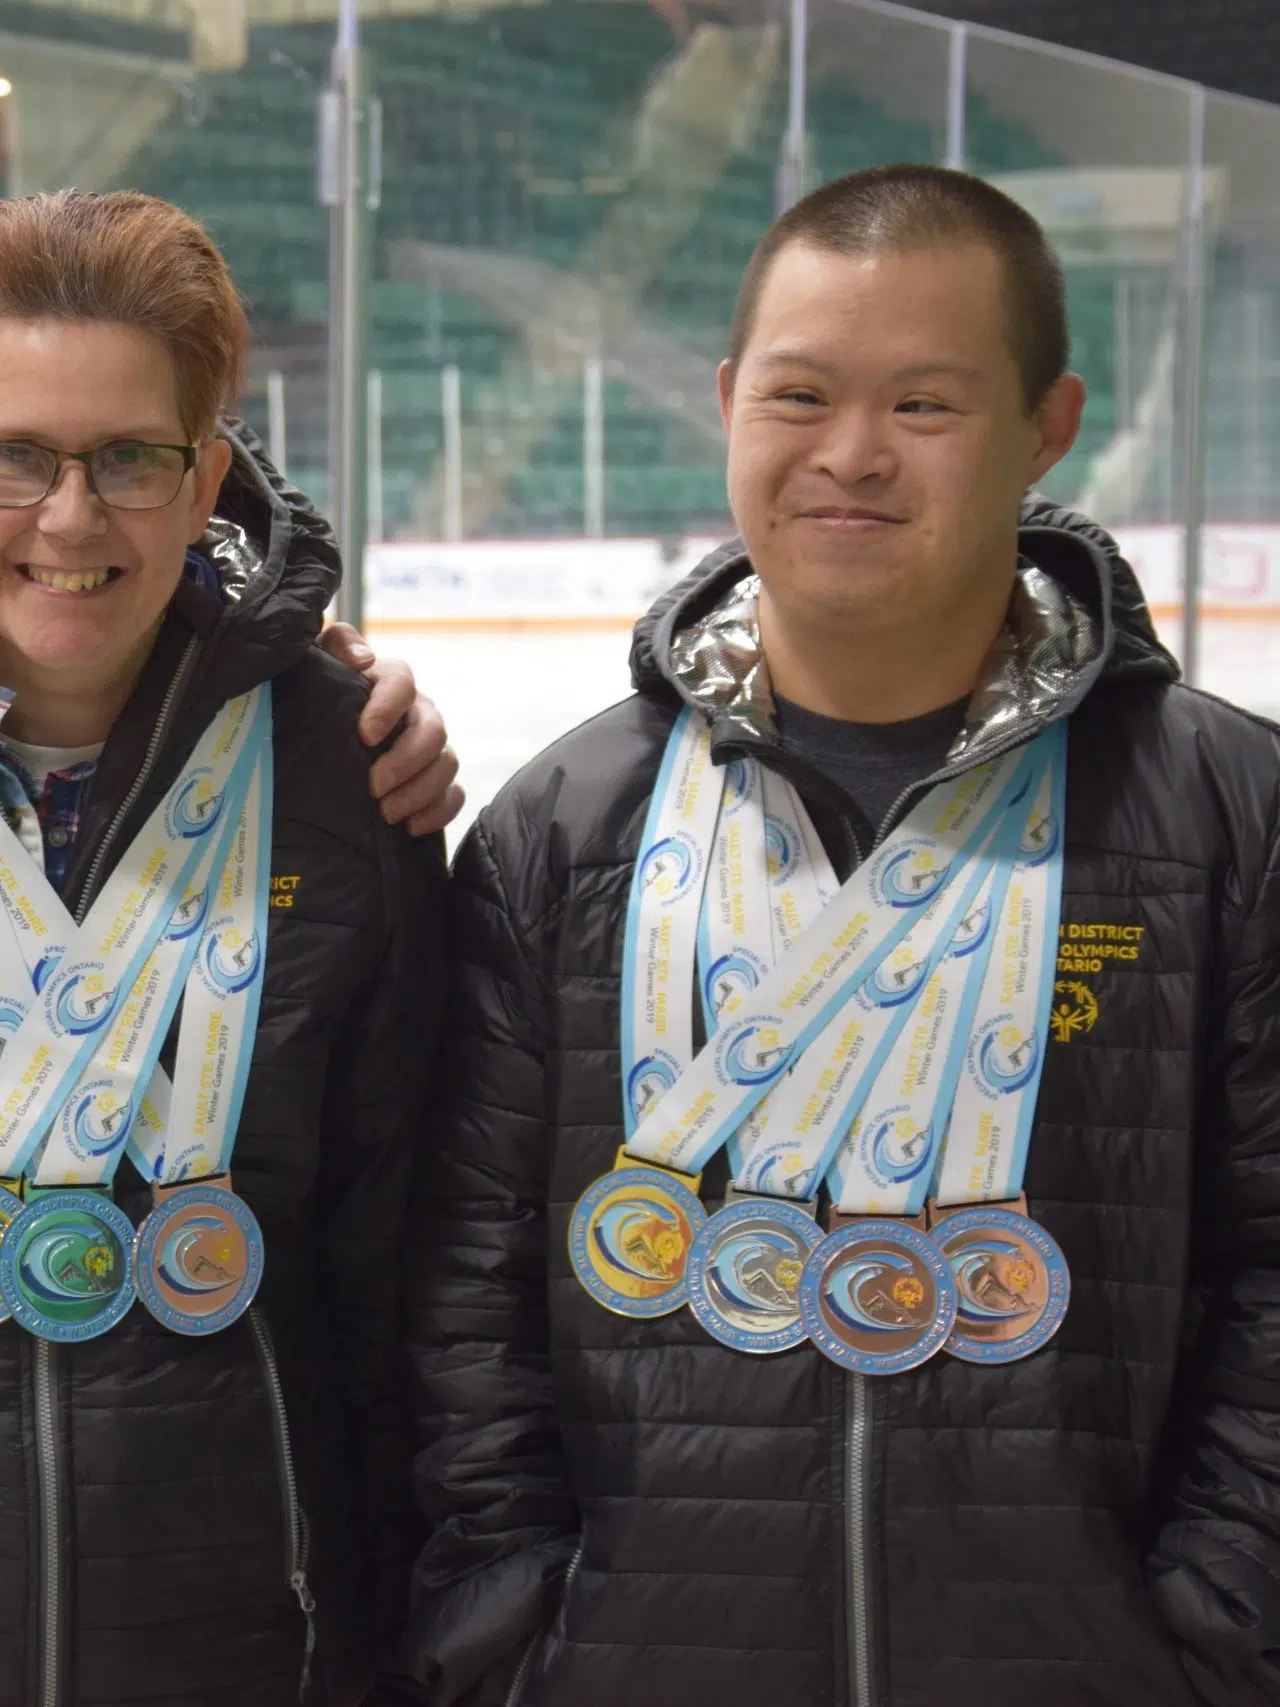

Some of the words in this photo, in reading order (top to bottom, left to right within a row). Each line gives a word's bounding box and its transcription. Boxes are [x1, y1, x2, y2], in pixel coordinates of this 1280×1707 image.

[11, 907, 30, 930] 2019
[116, 920, 137, 948] Winter
[134, 887, 155, 917] Games
[151, 862, 168, 885] 2019
[722, 901, 731, 925] 2019
[647, 926, 660, 960] Winter
[1015, 964, 1027, 994] Winter
[1022, 898, 1033, 927] 2019
[1070, 924, 1144, 940] DISTRICT
[68, 961, 104, 974] ONTARIO
[798, 977, 826, 1008] Winter
[823, 950, 852, 979] Games
[852, 928, 869, 952] 2019
[1056, 958, 1102, 972] TARIO
[1060, 944, 1139, 960] OLYMPICS
[647, 962, 657, 997] Games
[121, 1031, 138, 1062] Winter
[133, 996, 152, 1028] Games
[146, 969, 160, 994] 2019
[645, 998, 655, 1025] 2019
[219, 1025, 230, 1052] 2019
[917, 1052, 933, 1086] Winter
[926, 1016, 943, 1051] Games
[935, 987, 949, 1016] 2019
[79, 1080, 113, 1095] ONTARIO
[213, 1054, 226, 1088] Games
[813, 1093, 833, 1125] Winter
[830, 1061, 851, 1093] Games
[849, 1035, 865, 1062] 2019
[17, 1084, 40, 1117] Games
[35, 1060, 53, 1084] 2019
[206, 1090, 219, 1124] Winter
[672, 1128, 698, 1157] Games
[694, 1106, 715, 1128] 2019
[983, 1156, 997, 1191] Games
[990, 1126, 1001, 1156] 2019
